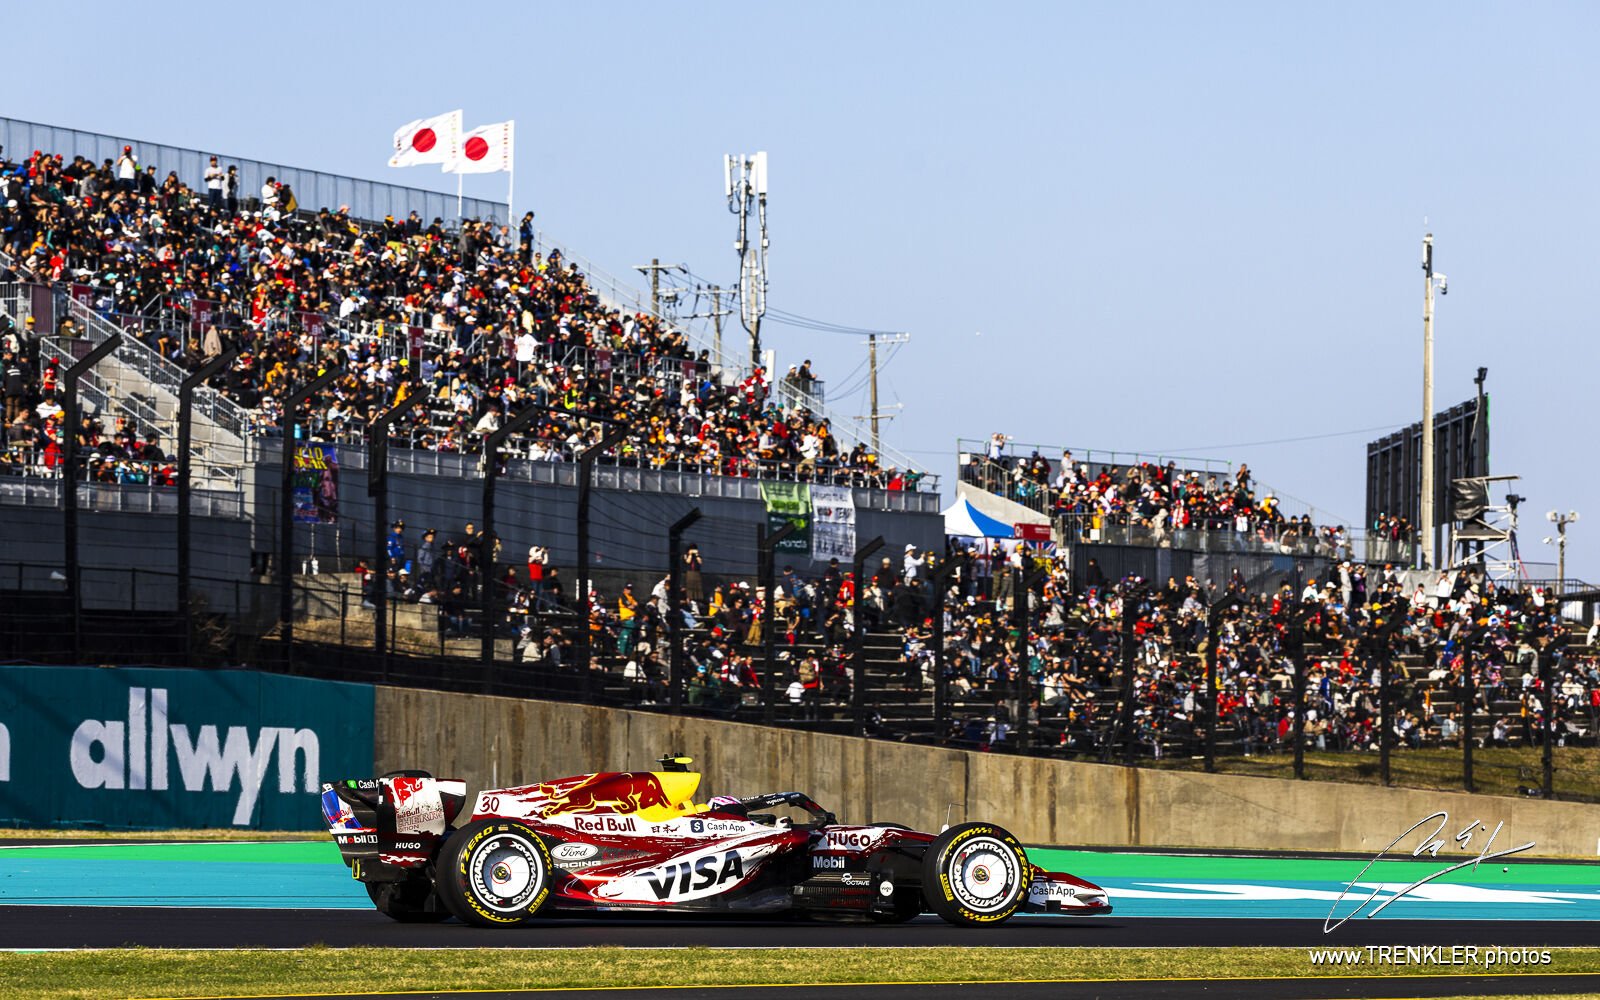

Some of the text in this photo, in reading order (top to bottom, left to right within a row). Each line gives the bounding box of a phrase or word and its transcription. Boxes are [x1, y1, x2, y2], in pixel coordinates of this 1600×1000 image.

[70, 687, 320, 825] allwyn
[358, 780, 375, 789] Cash
[479, 796, 499, 812] 30
[574, 817, 637, 832] Red Bull
[707, 823, 745, 833] Cash App
[338, 835, 367, 844] Mobil
[827, 833, 871, 846] HUGO
[460, 825, 494, 875] P ZERO
[560, 845, 588, 858] Ford
[813, 856, 845, 869] Mobil
[1005, 836, 1029, 889] P ZERO
[633, 850, 744, 900] VISA
[1032, 886, 1075, 895] Cash App
